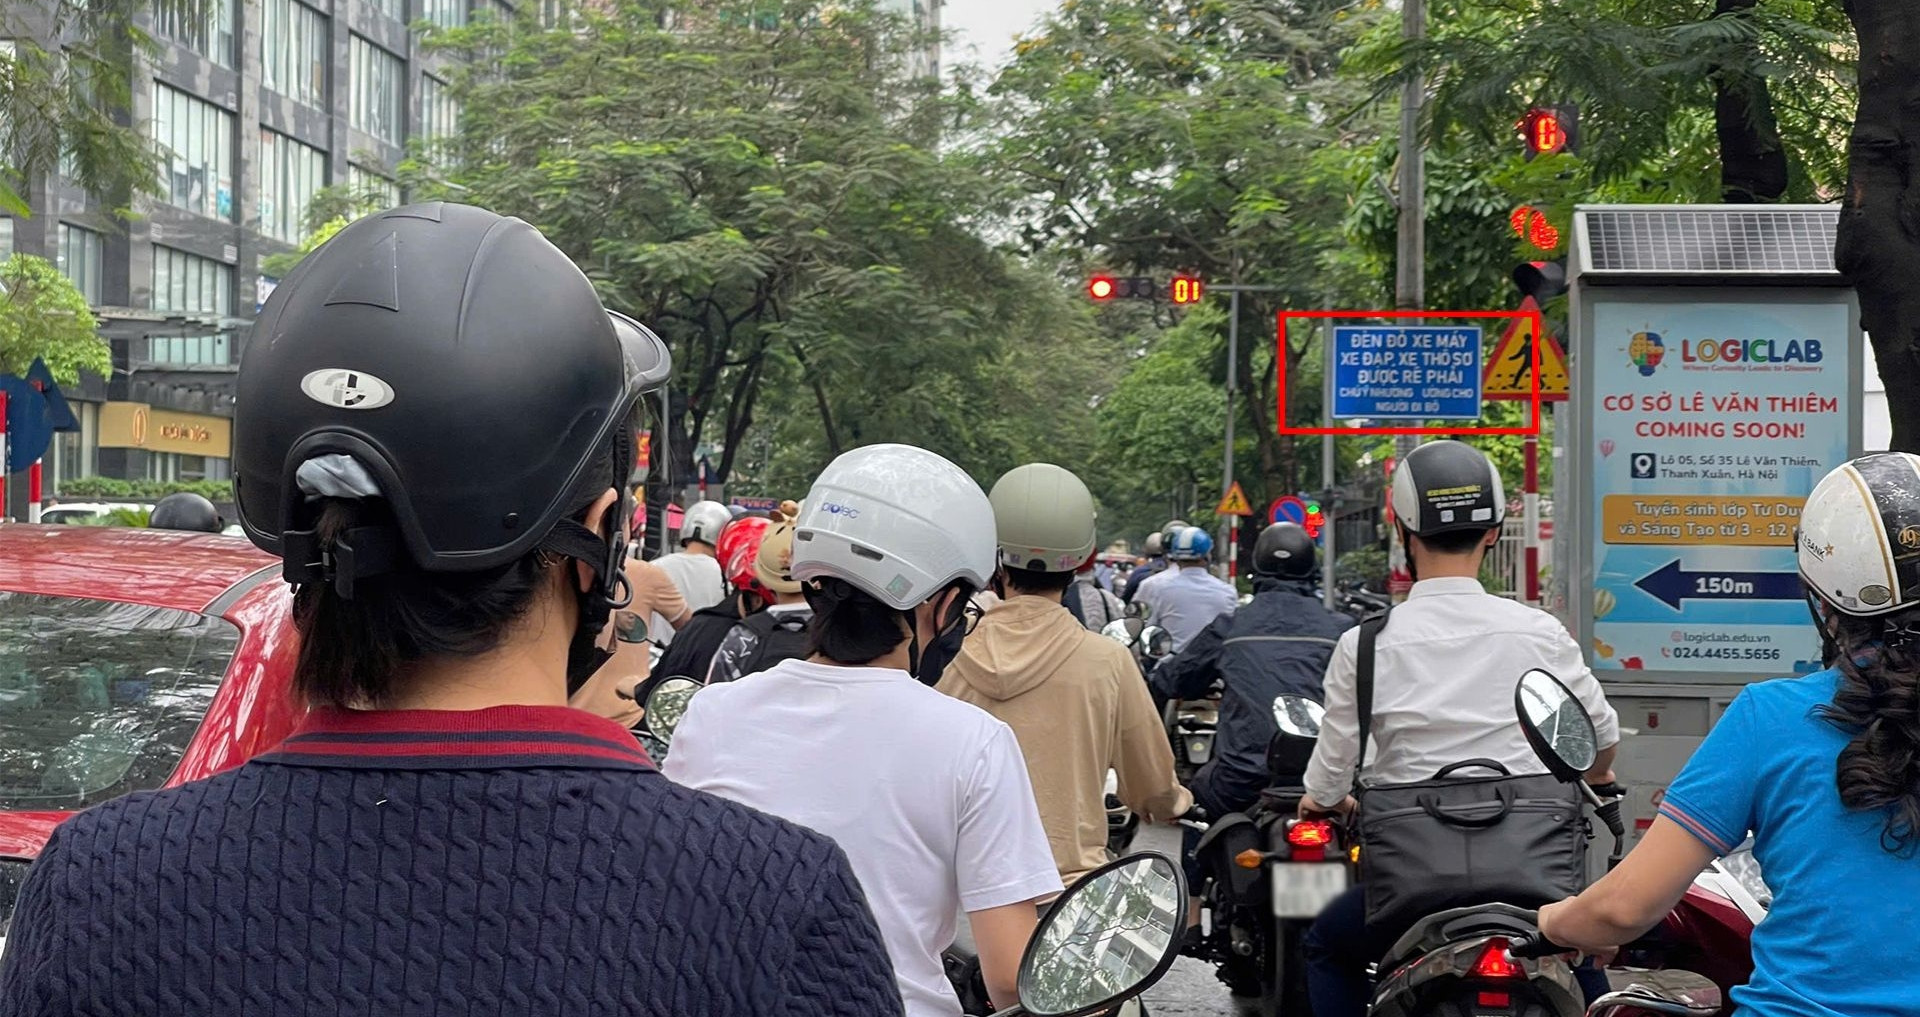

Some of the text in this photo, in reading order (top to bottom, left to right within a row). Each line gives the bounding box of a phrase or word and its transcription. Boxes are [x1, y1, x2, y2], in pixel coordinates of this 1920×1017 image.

[1174, 279, 1199, 302] 01
[1351, 329, 1468, 348] ĐÈN ĐỎ XE MÁY
[1340, 352, 1360, 366] XE
[1398, 352, 1418, 366] XE
[1681, 338, 1823, 363] LOGICLAB
[1357, 368, 1399, 386] ĐƯỢC
[1426, 365, 1463, 384] PHẢI
[1603, 391, 1838, 413] CƠ SỞ LÊ VĂN THIÊM
[1635, 421, 1805, 439] COMING SOON!
[1660, 454, 1675, 465] Lô
[1678, 455, 1696, 466] 05,
[1699, 453, 1715, 465] Số
[1718, 455, 1733, 466] 35
[1736, 455, 1751, 466] Lê
[1754, 455, 1777, 466] Văn
[1660, 469, 1698, 479] Thanh
[1738, 470, 1754, 479] Hà
[1758, 470, 1778, 481] Nội
[1685, 502, 1717, 516] sinh
[1722, 502, 1747, 518] lớp
[1752, 502, 1771, 516] Tư
[1619, 520, 1636, 535] và
[1641, 520, 1681, 538] Sáng
[1686, 522, 1715, 539] Tạo
[1720, 521, 1737, 536] từ
[1740, 524, 1750, 536] 3
[1767, 524, 1787, 536] 12
[1695, 577, 1753, 594] 150m
[1683, 632, 1771, 645] logiclab.edu.vn
[1673, 647, 1780, 660] 024.4455.5656
